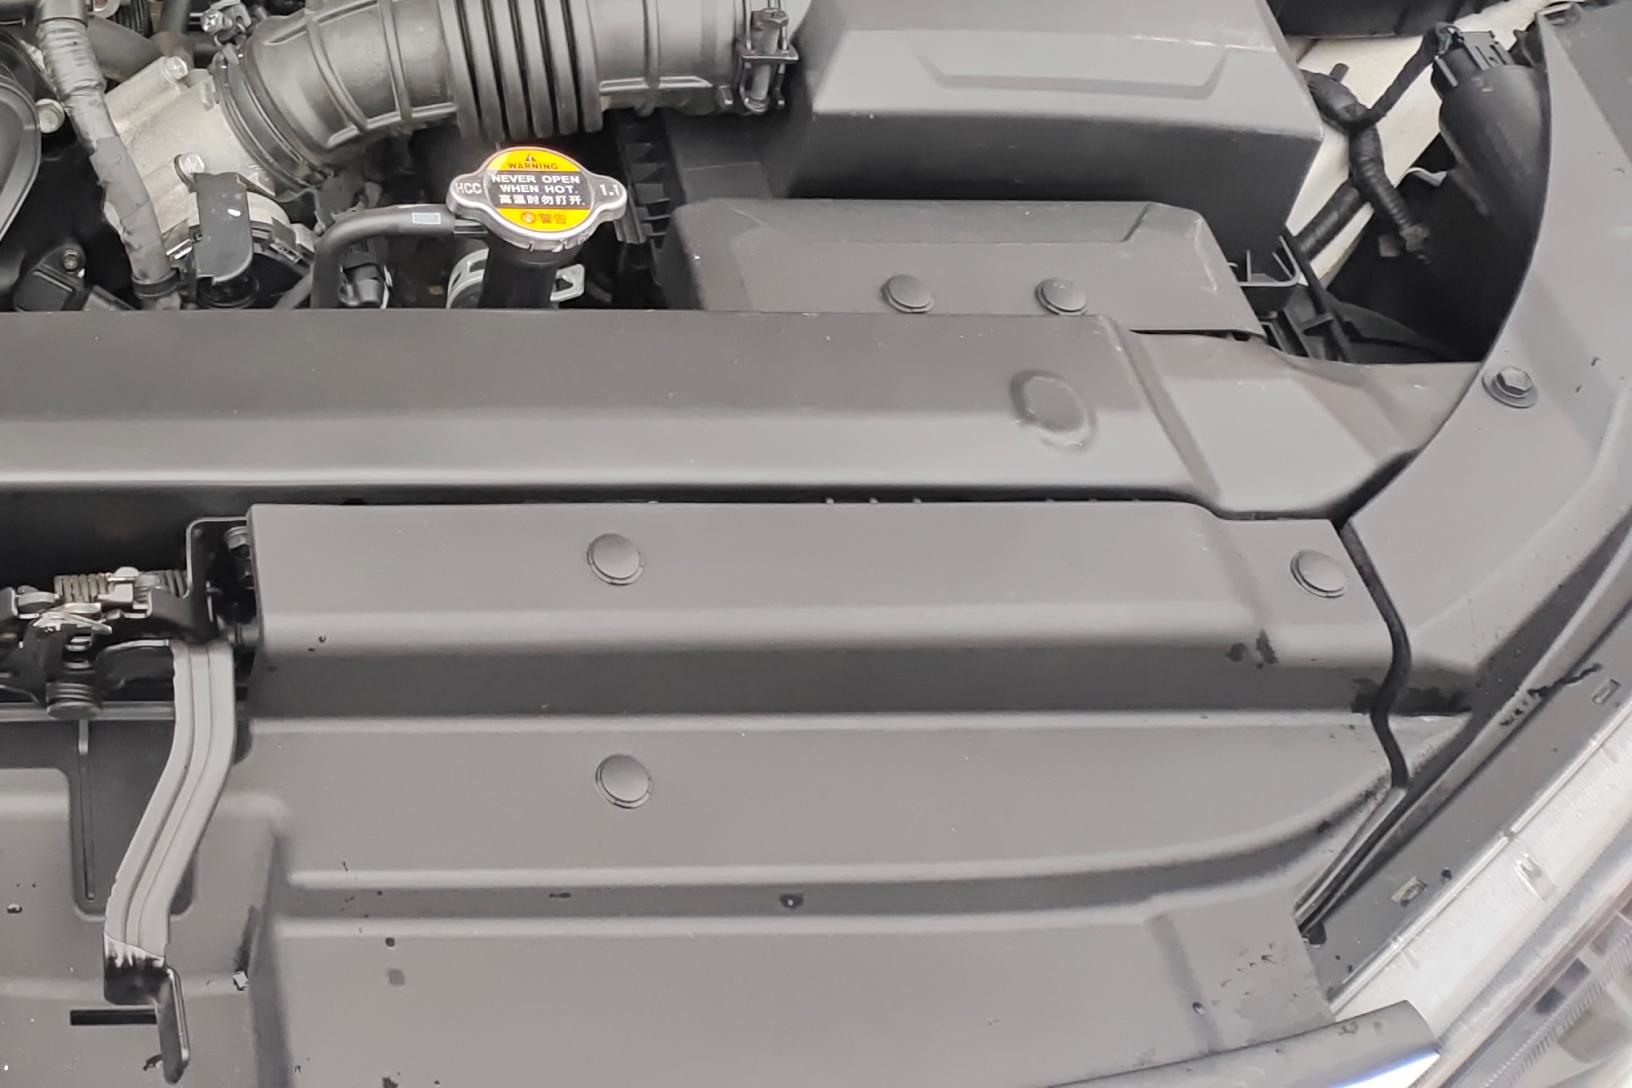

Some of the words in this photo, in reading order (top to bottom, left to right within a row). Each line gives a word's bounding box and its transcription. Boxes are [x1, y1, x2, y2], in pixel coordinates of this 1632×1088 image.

[508, 162, 558, 171] WARNING
[491, 174, 536, 183] NEVER
[541, 175, 580, 184] OPEN
[454, 182, 483, 195] HCC
[499, 184, 539, 193] WHEN
[539, 213, 567, 225] 警告
